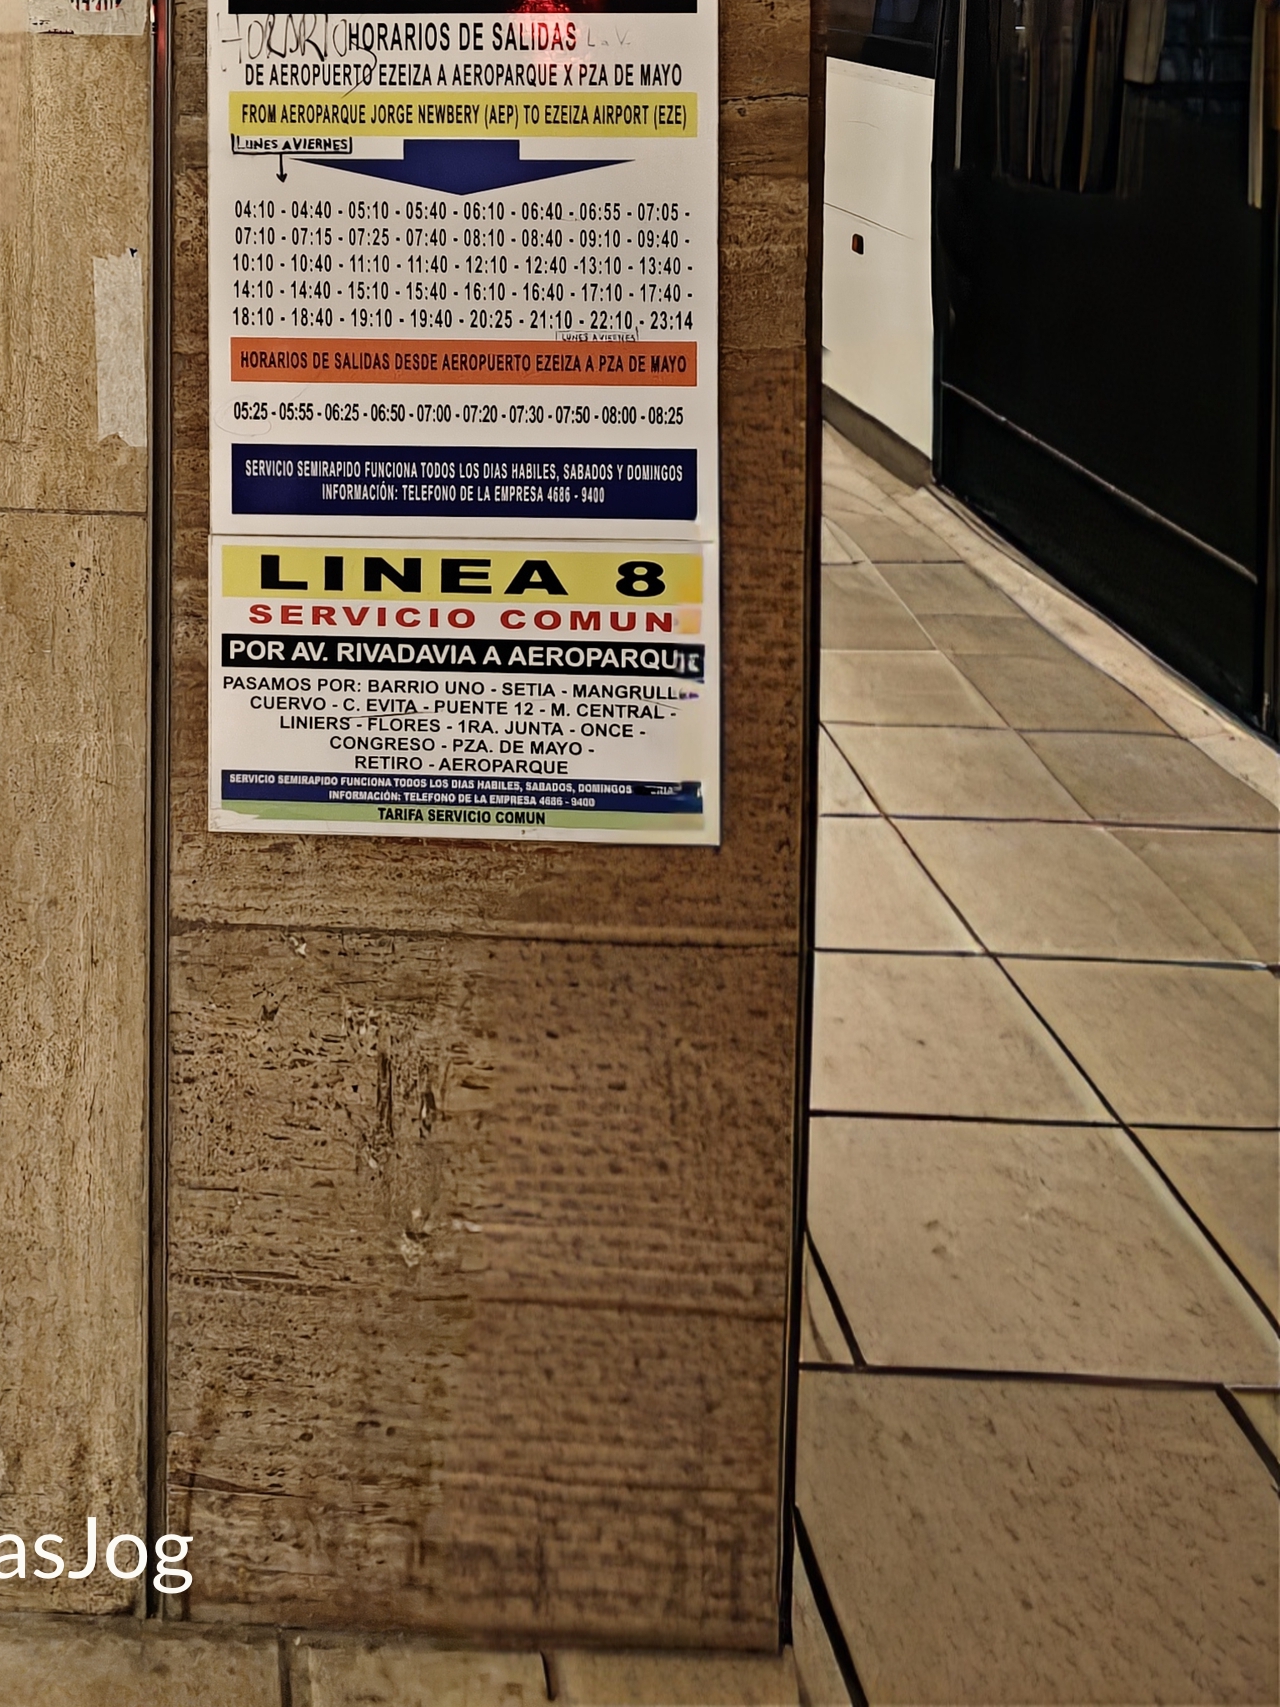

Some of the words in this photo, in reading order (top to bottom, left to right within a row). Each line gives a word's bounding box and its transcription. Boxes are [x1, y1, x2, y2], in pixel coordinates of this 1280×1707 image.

[348, 22, 450, 53] HORARIOS
[459, 22, 484, 51] DE
[492, 22, 577, 51] SALIDAS
[245, 63, 264, 86] DE
[268, 63, 372, 86] AEROPUERTO
[377, 63, 432, 87] EZEIZA
[437, 63, 447, 86] A
[452, 63, 558, 87] AEROPARQUE
[563, 64, 573, 86] X
[579, 64, 609, 86] PZA
[614, 63, 634, 86] DE
[640, 63, 682, 86] MAYO
[242, 104, 276, 124] FROM
[280, 104, 366, 125] AEROPARQUE
[370, 104, 413, 124] JORGE
[418, 104, 480, 124] NEWBERY
[484, 104, 519, 129] (AEP)
[523, 104, 540, 125] TO
[544, 105, 589, 125] EZEIZA
[592, 104, 649, 125] AIRPORT
[653, 105, 687, 130] (EZE)
[236, 136, 278, 150] LUNES
[293, 137, 348, 151] VIERNES
[235, 200, 275, 219] 04:10
[291, 200, 332, 219] 04:40
[348, 201, 389, 220] 05:10
[406, 201, 447, 220] 05:40
[464, 201, 505, 220] 06:10
[521, 202, 563, 220] 06:40
[579, 202, 621, 221] 06:55
[637, 202, 679, 221] 07:05
[240, 351, 308, 369] HORARIOS
[312, 352, 330, 370] DE
[334, 352, 390, 370] SALIDAS
[395, 352, 438, 371] DESDE
[441, 353, 531, 372] AEROPUERTO
[536, 354, 582, 373] EZEIZA
[585, 354, 595, 373] A
[598, 354, 624, 373] PZA
[628, 355, 646, 373] DE
[650, 355, 687, 374] MAYO
[245, 459, 294, 477] SERVICIO
[297, 460, 361, 478] SEMIRAPIDO
[365, 461, 418, 478] FUNCIONA
[420, 462, 455, 479] TODOS
[459, 462, 479, 479] LOS
[483, 462, 508, 479] DIAS
[511, 463, 559, 481] HABILES,
[563, 463, 613, 480] SABADOS
[616, 464, 624, 480] Y
[627, 464, 683, 482] DOMINGOS
[260, 554, 569, 596] LINEA
[615, 561, 666, 597] 8
[249, 604, 475, 629] SERVICIO
[500, 609, 672, 633] COMUN
[229, 640, 285, 661] POR
[291, 641, 328, 661] AV.
[337, 642, 477, 665] RIVADAVIA
[482, 645, 502, 666] A
[223, 676, 311, 691] PASAMOS
[318, 678, 361, 693] POR:
[368, 679, 439, 694] BARRIO
[445, 681, 485, 695] UNO
[502, 682, 556, 697] SETIA
[250, 695, 326, 711] CUERVO
[343, 698, 360, 712] C.
[366, 698, 419, 715] EVITA
[434, 700, 508, 715] PUENTE
[514, 701, 534, 716] 12
[551, 702, 570, 717] M.
[576, 702, 665, 719] CENTRAL
[278, 715, 351, 731] LINIERS
[366, 717, 441, 733] FLORES
[458, 719, 499, 734] 1RA.
[504, 720, 564, 736] JUNTA
[581, 722, 634, 738] ONCE
[329, 735, 435, 751] CONGRESO
[453, 738, 493, 753] PZA.
[499, 740, 524, 754] DE
[530, 740, 582, 756] MAYO
[355, 755, 423, 770] RETIRO
[438, 757, 568, 775] AEROPARQUE
[377, 807, 424, 822] TARIFA
[428, 809, 491, 823] SERVICIO
[495, 808, 549, 825] COMUN
